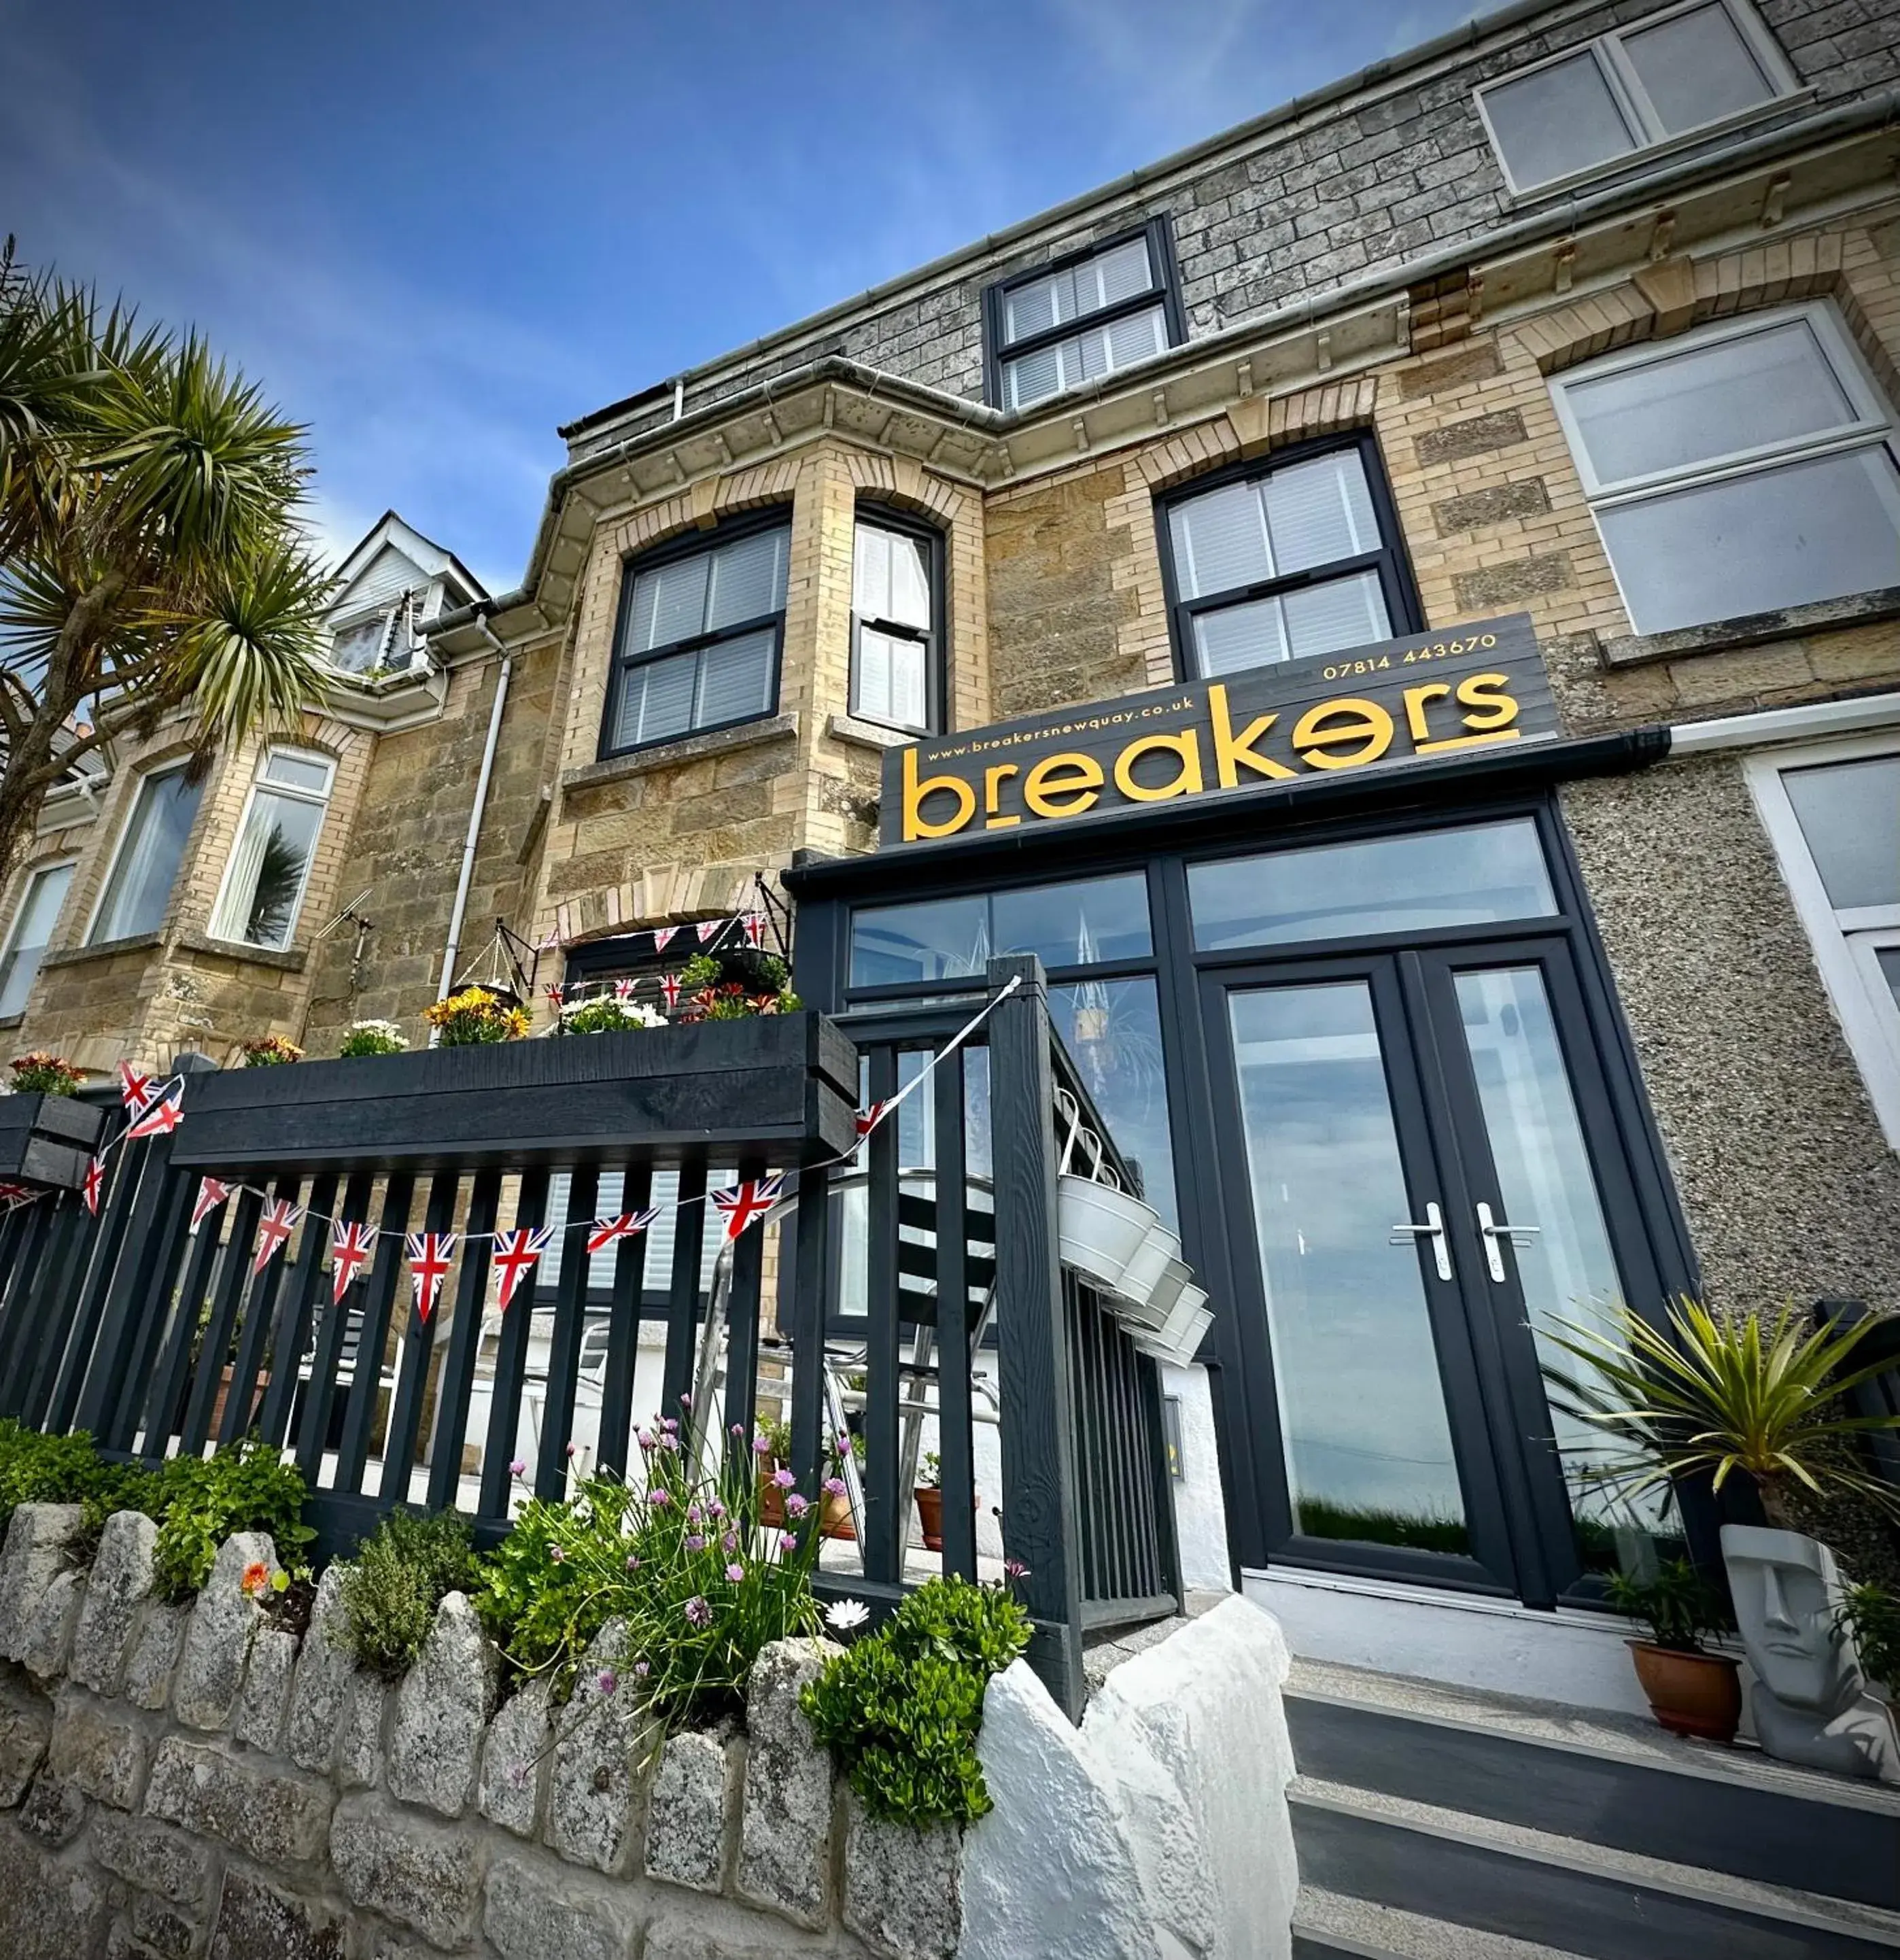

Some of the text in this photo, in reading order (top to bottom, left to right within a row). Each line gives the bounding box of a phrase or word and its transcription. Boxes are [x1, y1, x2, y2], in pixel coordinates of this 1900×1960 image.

[1323, 634, 1496, 680] 07814 443670
[903, 673, 1521, 842] breakers
[928, 695, 1195, 763] www.breakersnewquay.co.uk
